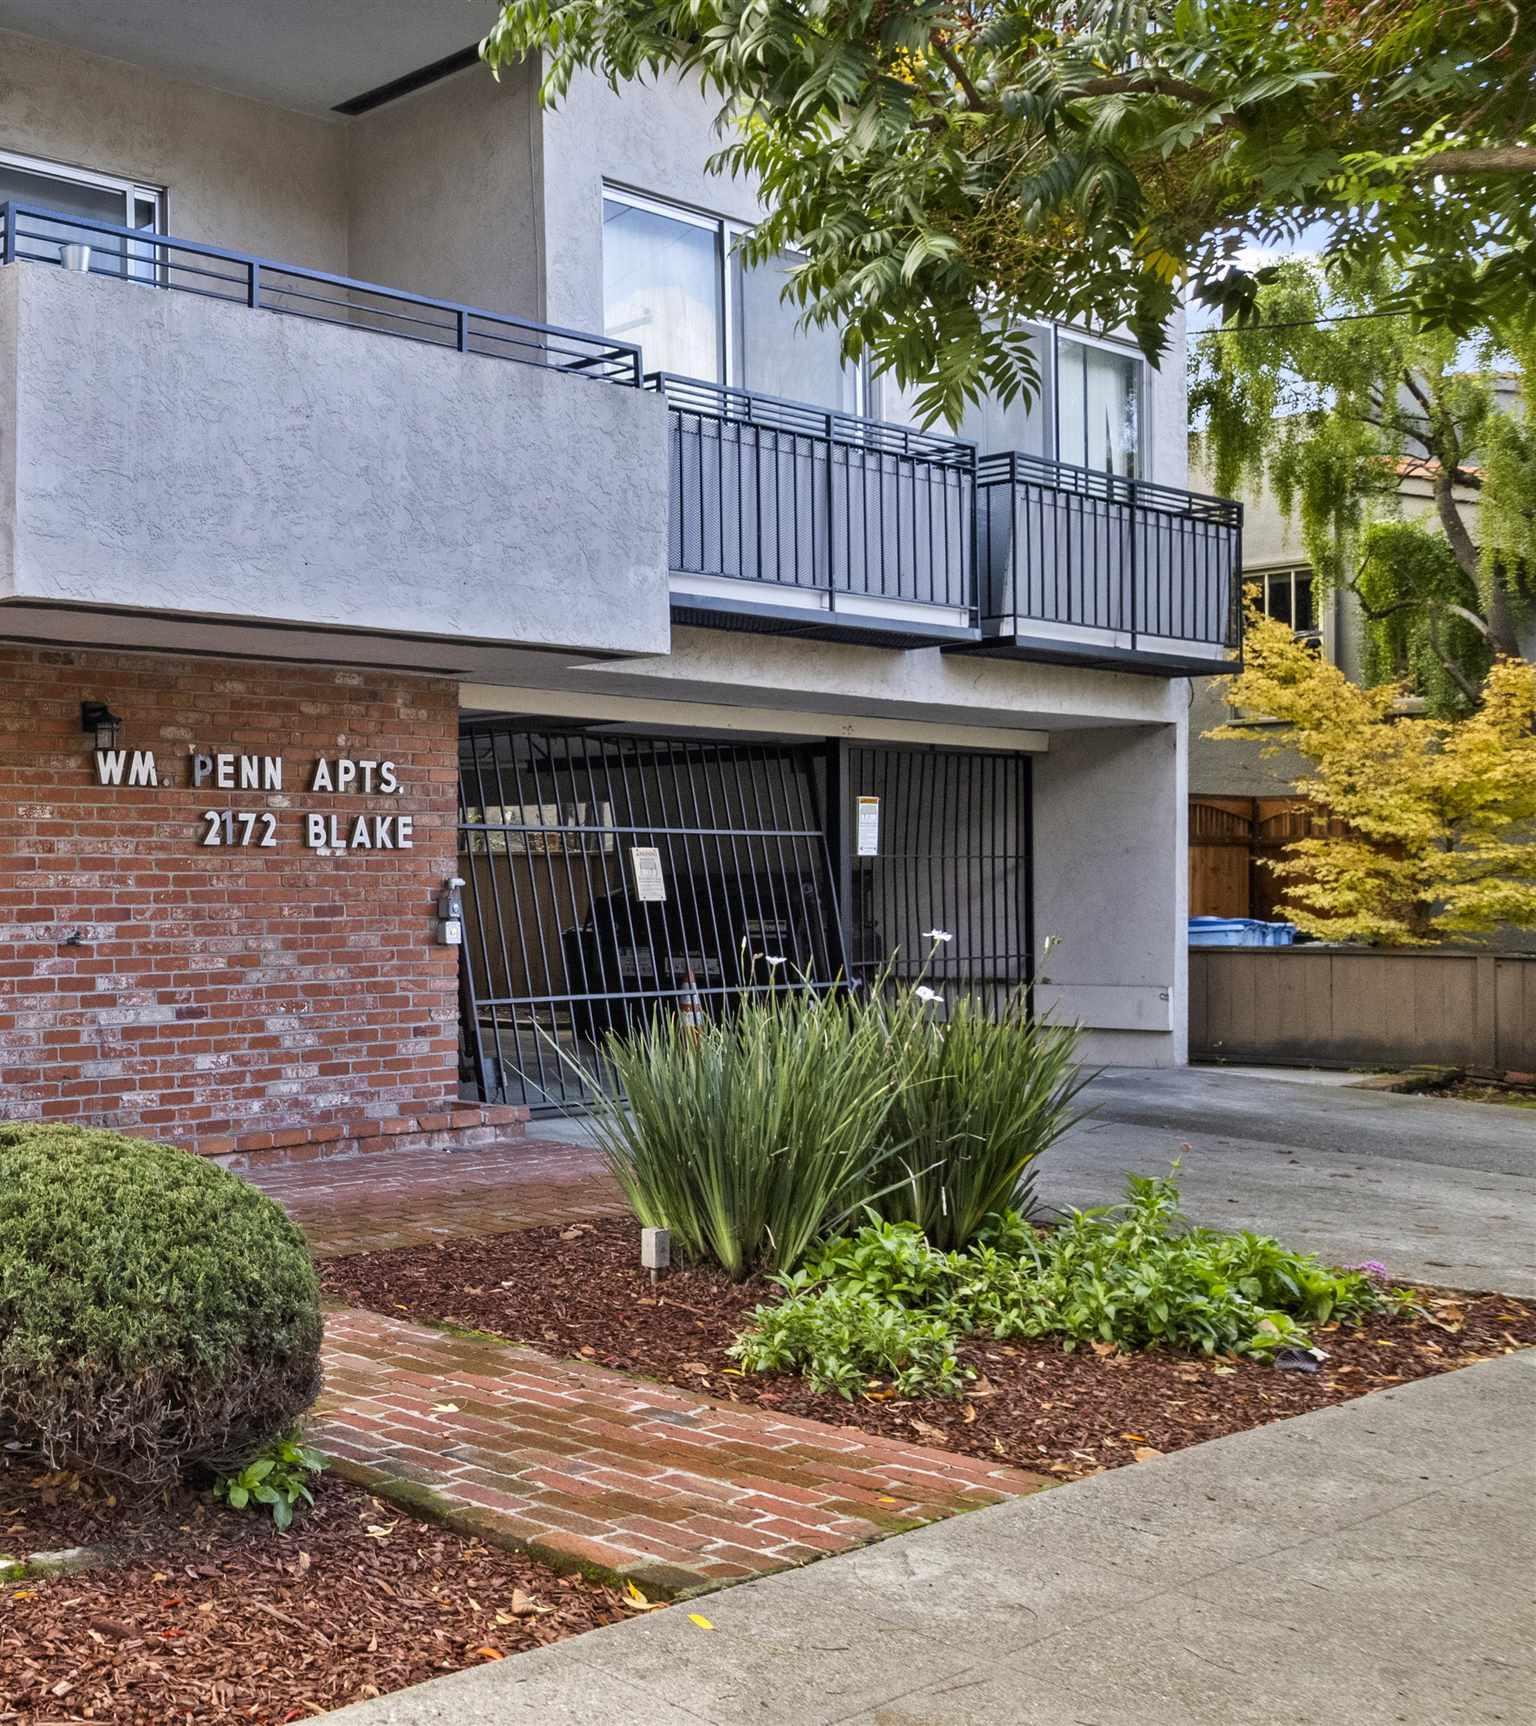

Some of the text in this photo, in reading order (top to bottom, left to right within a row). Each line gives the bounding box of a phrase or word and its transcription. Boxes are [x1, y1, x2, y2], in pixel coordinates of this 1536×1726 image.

[96, 750, 404, 794] WM. PENN APTS.
[203, 810, 413, 849] 2172 BLAKE
